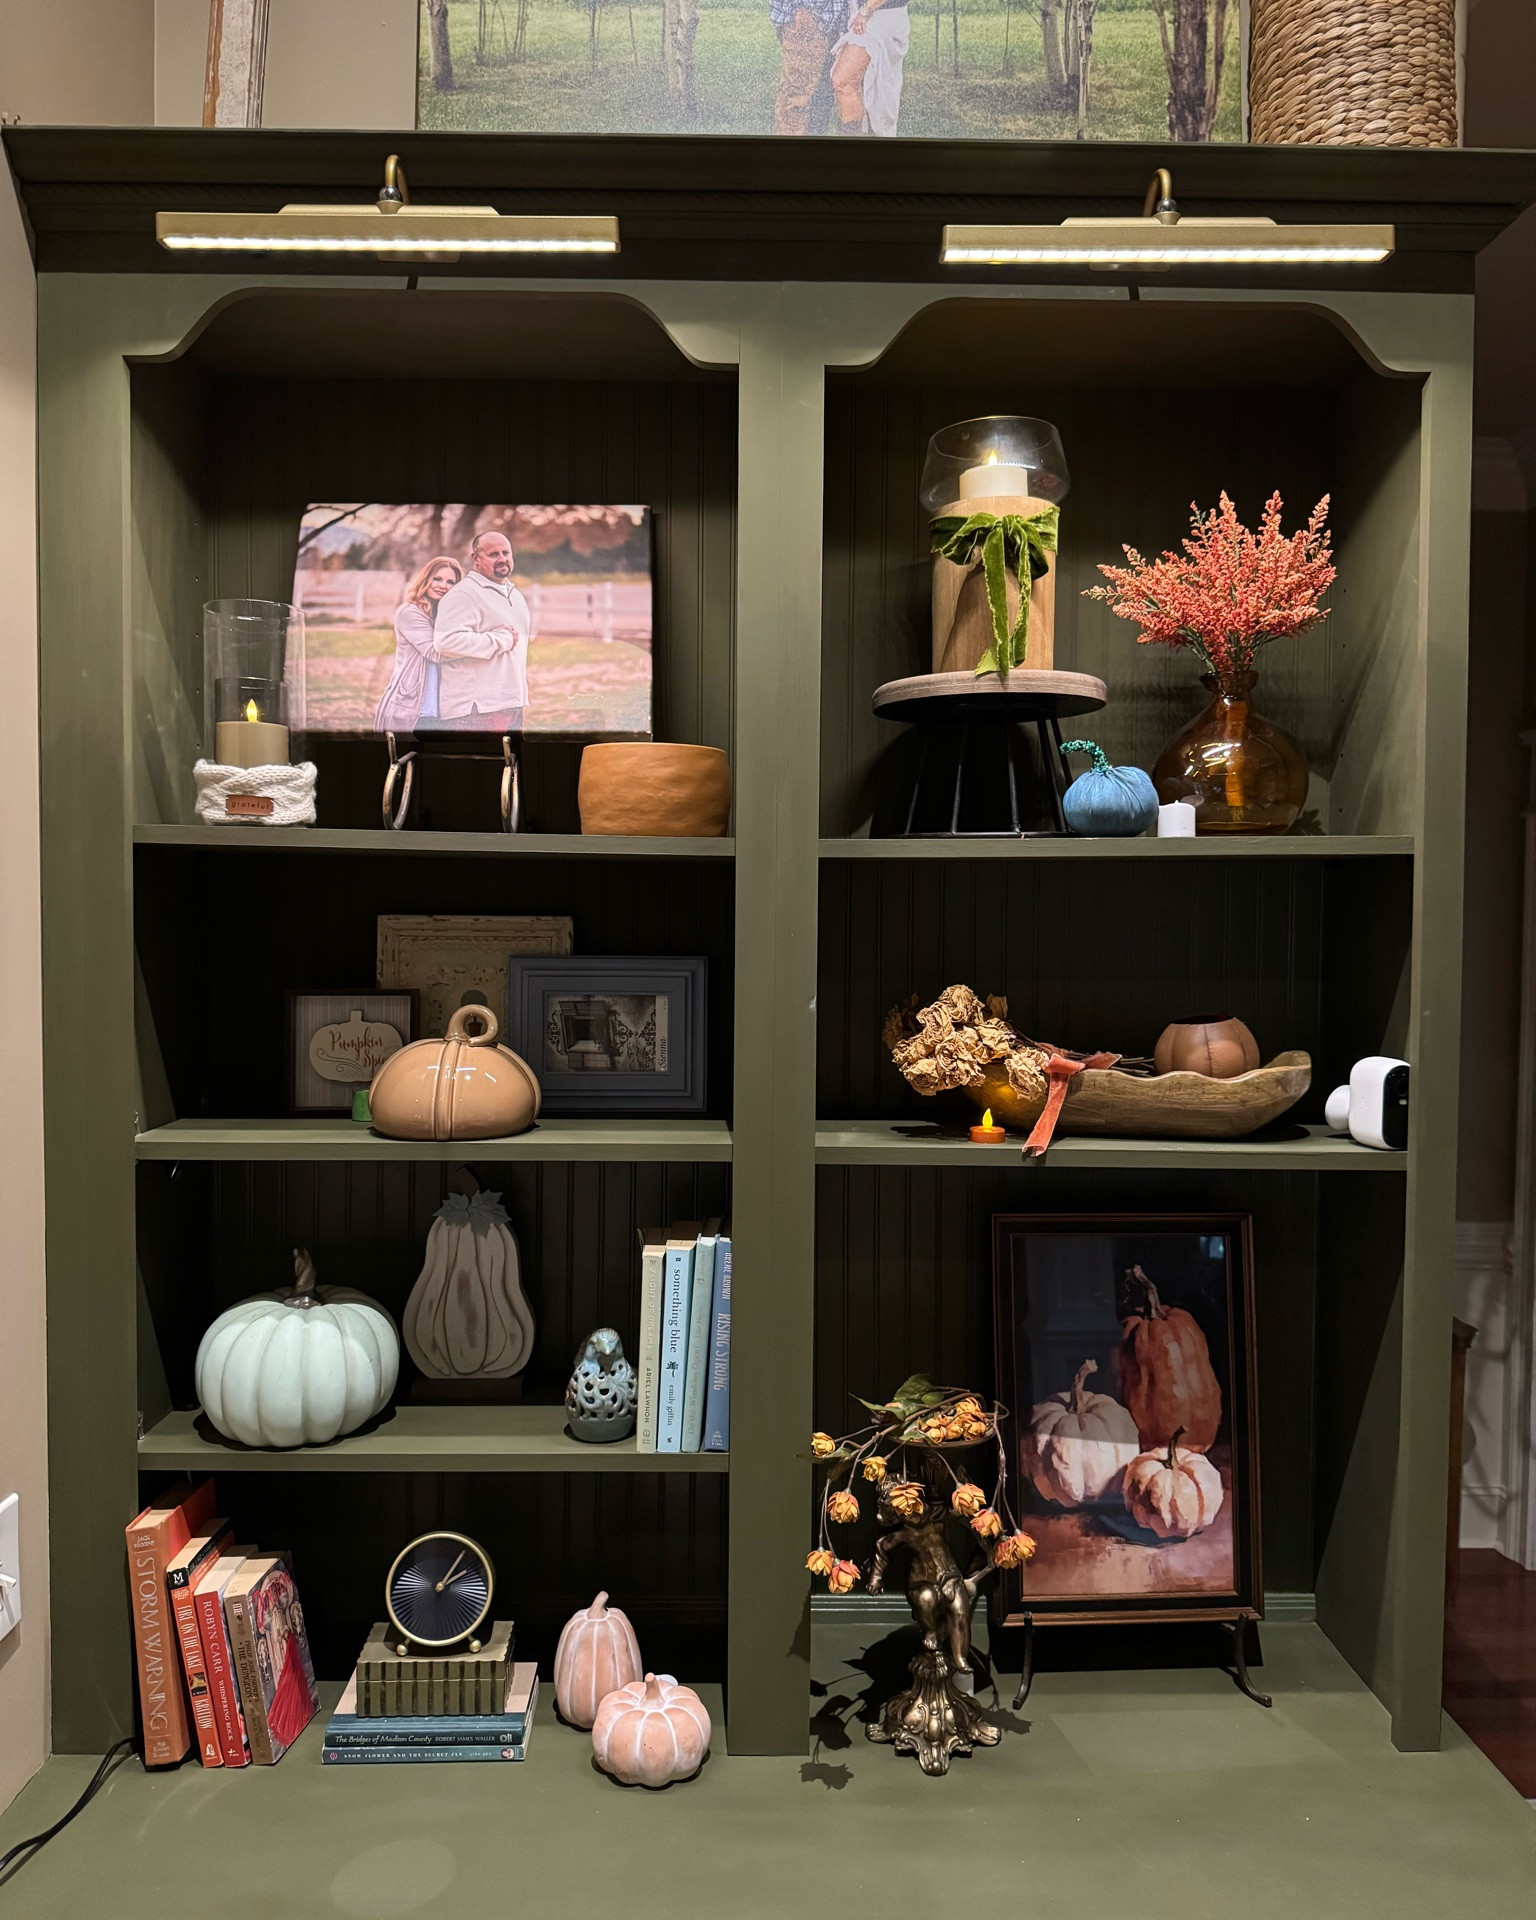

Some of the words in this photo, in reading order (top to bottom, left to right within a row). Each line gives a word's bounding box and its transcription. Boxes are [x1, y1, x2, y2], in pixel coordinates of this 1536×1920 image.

[231, 801, 269, 809] grateful
[329, 1026, 383, 1061] Pumpkin
[363, 1048, 389, 1081] Spic
[668, 1269, 682, 1326] something
[721, 1275, 731, 1300] BROWN
[670, 1329, 681, 1353] blue
[716, 1313, 731, 1347] RISING
[713, 1350, 729, 1391] STRONG
[666, 1385, 676, 1403] emily
[689, 1372, 698, 1408] Windows
[137, 1557, 160, 1629] STORM
[181, 1623, 196, 1635] ON
[203, 1601, 218, 1639] ROBYN
[183, 1636, 199, 1650] THE
[186, 1650, 202, 1669] LAKE
[210, 1642, 223, 1674] CARR
[238, 1646, 247, 1660] THE
[144, 1632, 168, 1730] WARNING
[240, 1662, 253, 1698] DUNGEON
[219, 1680, 231, 1721] WHISPERING
[226, 1722, 234, 1741] ROCK
[335, 1735, 347, 1743] The
[348, 1735, 371, 1744] Bridges
[372, 1734, 380, 1744] of
[380, 1735, 407, 1743] Madison
[408, 1735, 432, 1744] County
